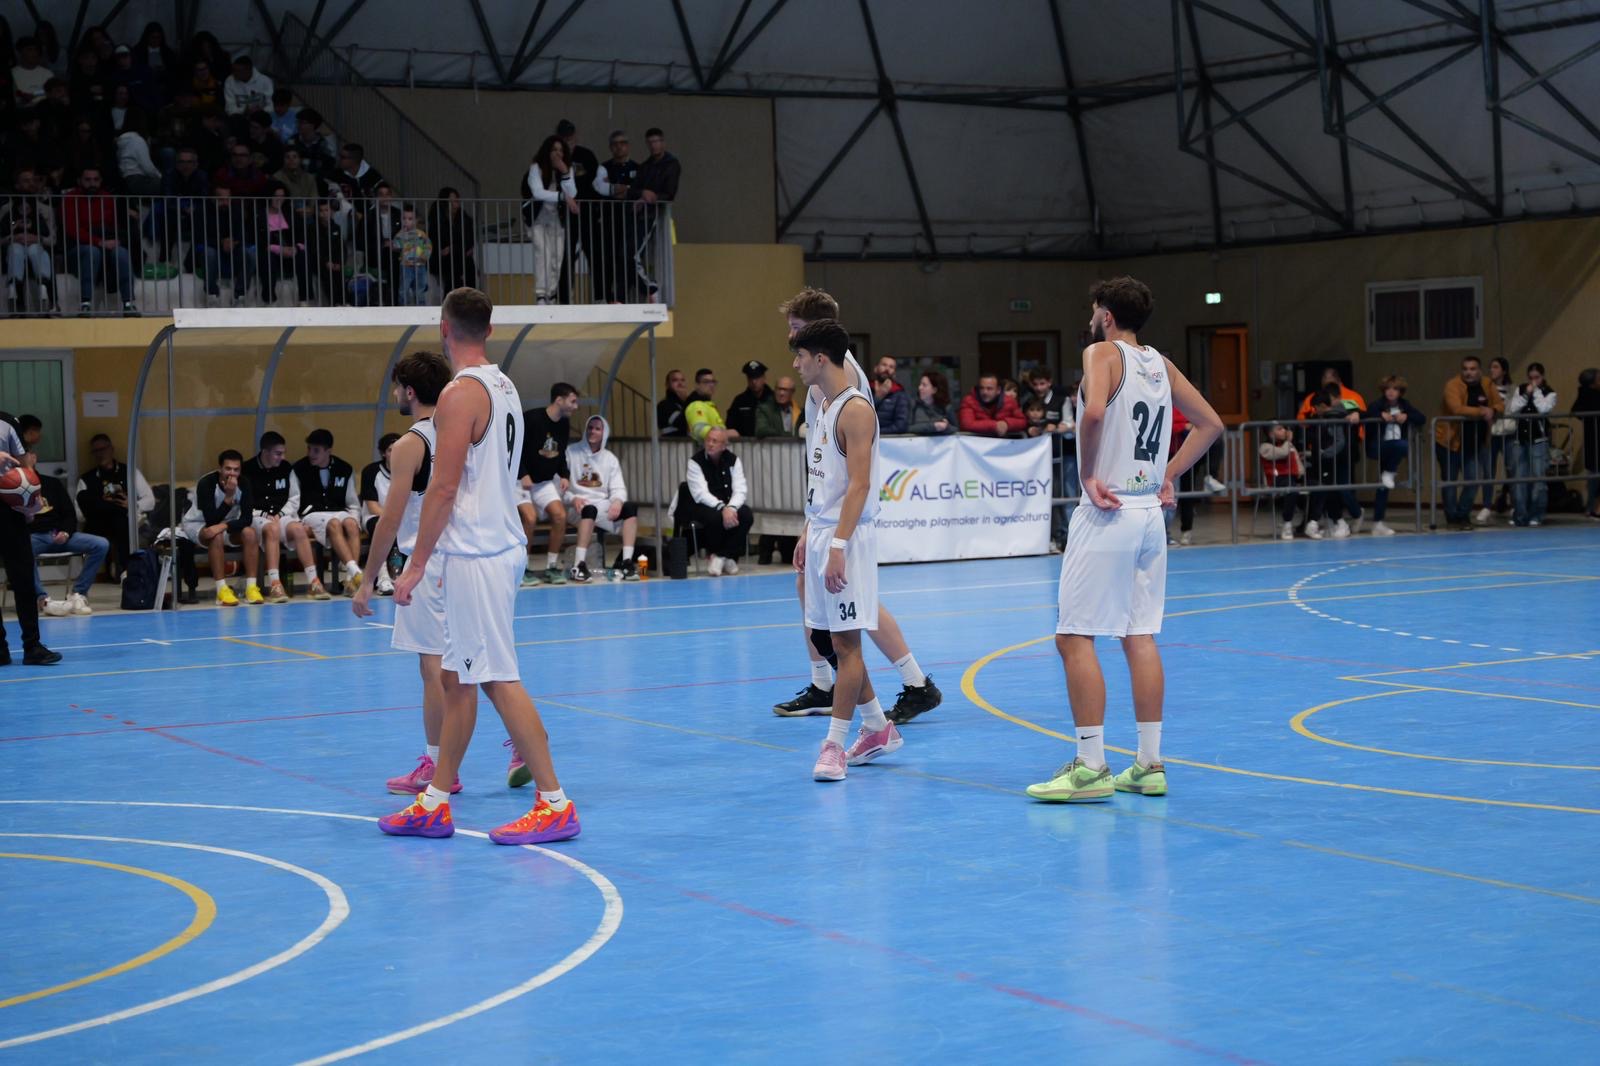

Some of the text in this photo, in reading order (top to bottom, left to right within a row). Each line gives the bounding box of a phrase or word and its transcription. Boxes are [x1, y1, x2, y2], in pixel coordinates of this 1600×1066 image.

[506, 412, 516, 473] 9
[1132, 401, 1166, 465] 24
[275, 478, 286, 490] M
[334, 476, 345, 488] M
[910, 478, 1051, 501] ALGAENERGY
[930, 516, 979, 528] playmaker
[982, 514, 991, 524] in
[993, 512, 1050, 526] agricoltura
[839, 601, 857, 621] 34
